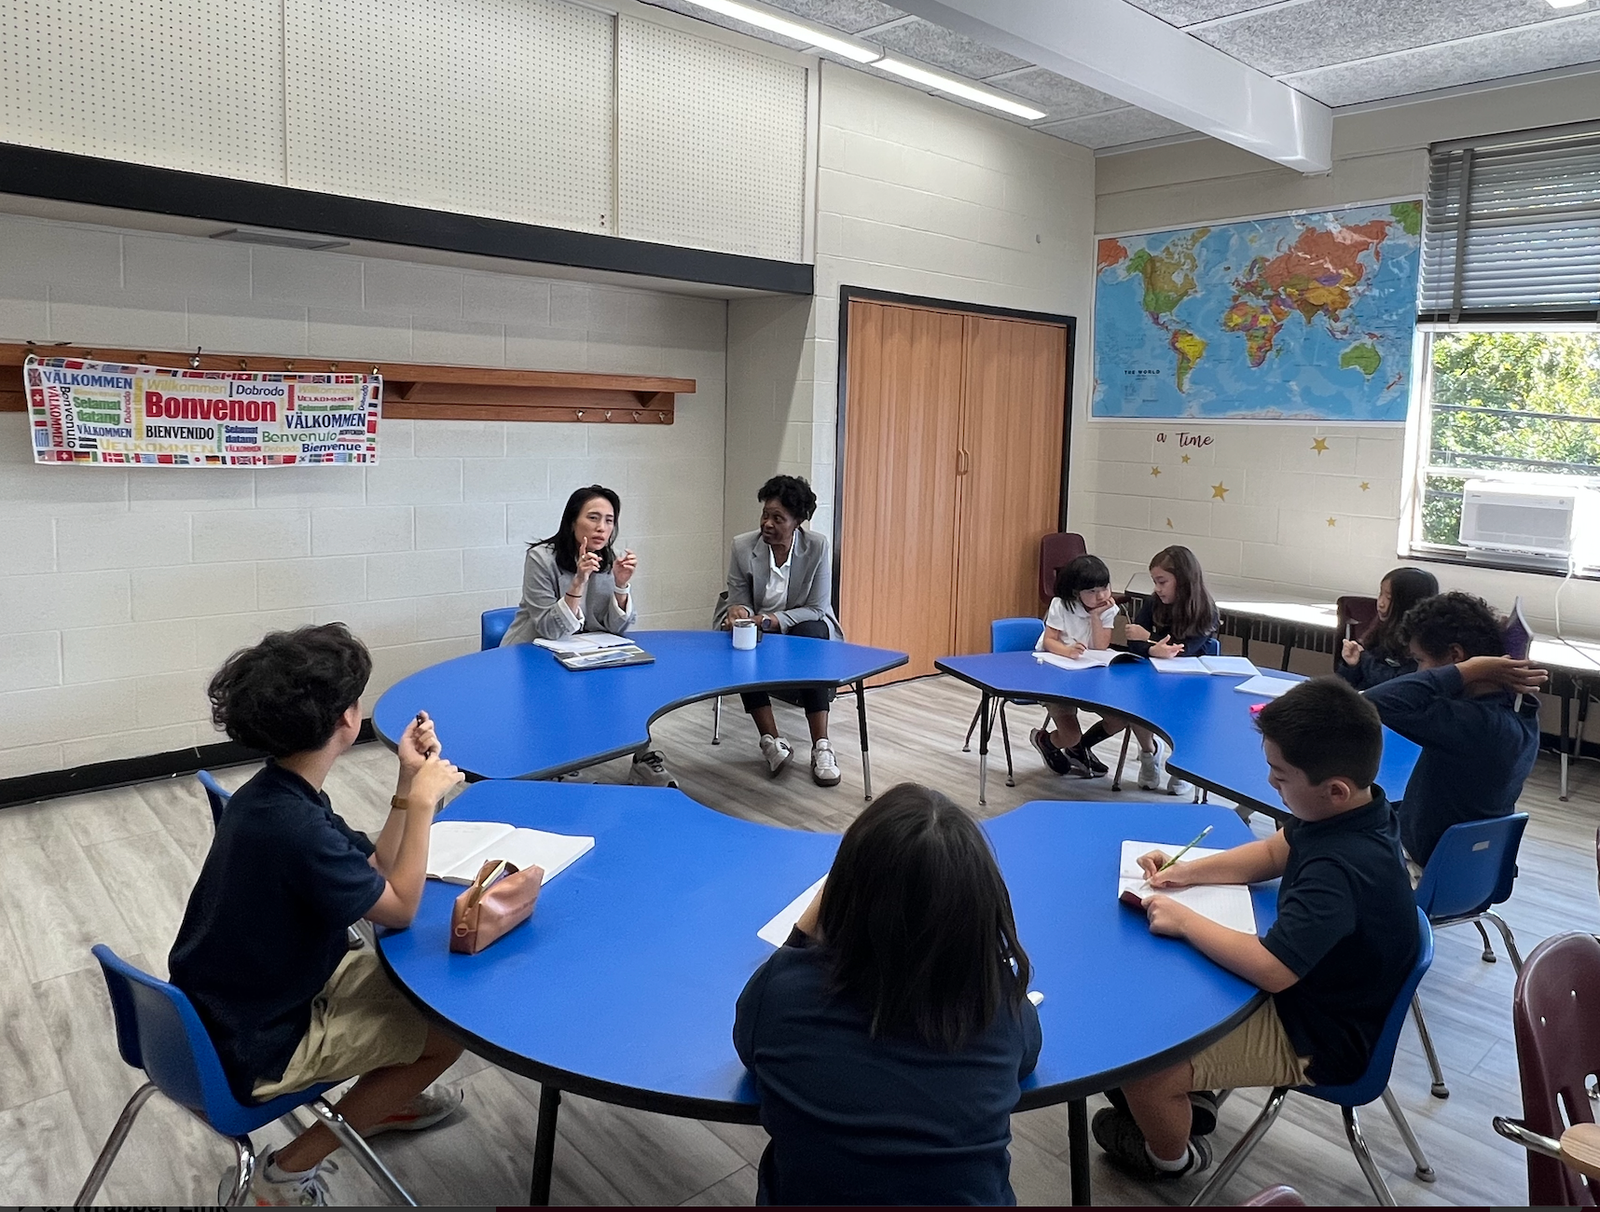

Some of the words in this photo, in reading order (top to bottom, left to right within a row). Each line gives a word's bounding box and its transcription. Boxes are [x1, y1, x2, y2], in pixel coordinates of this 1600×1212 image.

[43, 369, 132, 389] VÄLKOMMEN
[236, 384, 285, 396] Dobrodo
[73, 397, 121, 411] Selamat
[145, 391, 276, 422] Bonvenon
[285, 412, 366, 429] VÄLKOMMEN
[77, 424, 132, 438] VÄLKOMMEN
[146, 425, 215, 440] BIENVENIDO
[1157, 432, 1167, 443] a
[302, 443, 362, 453] Bienvenue
